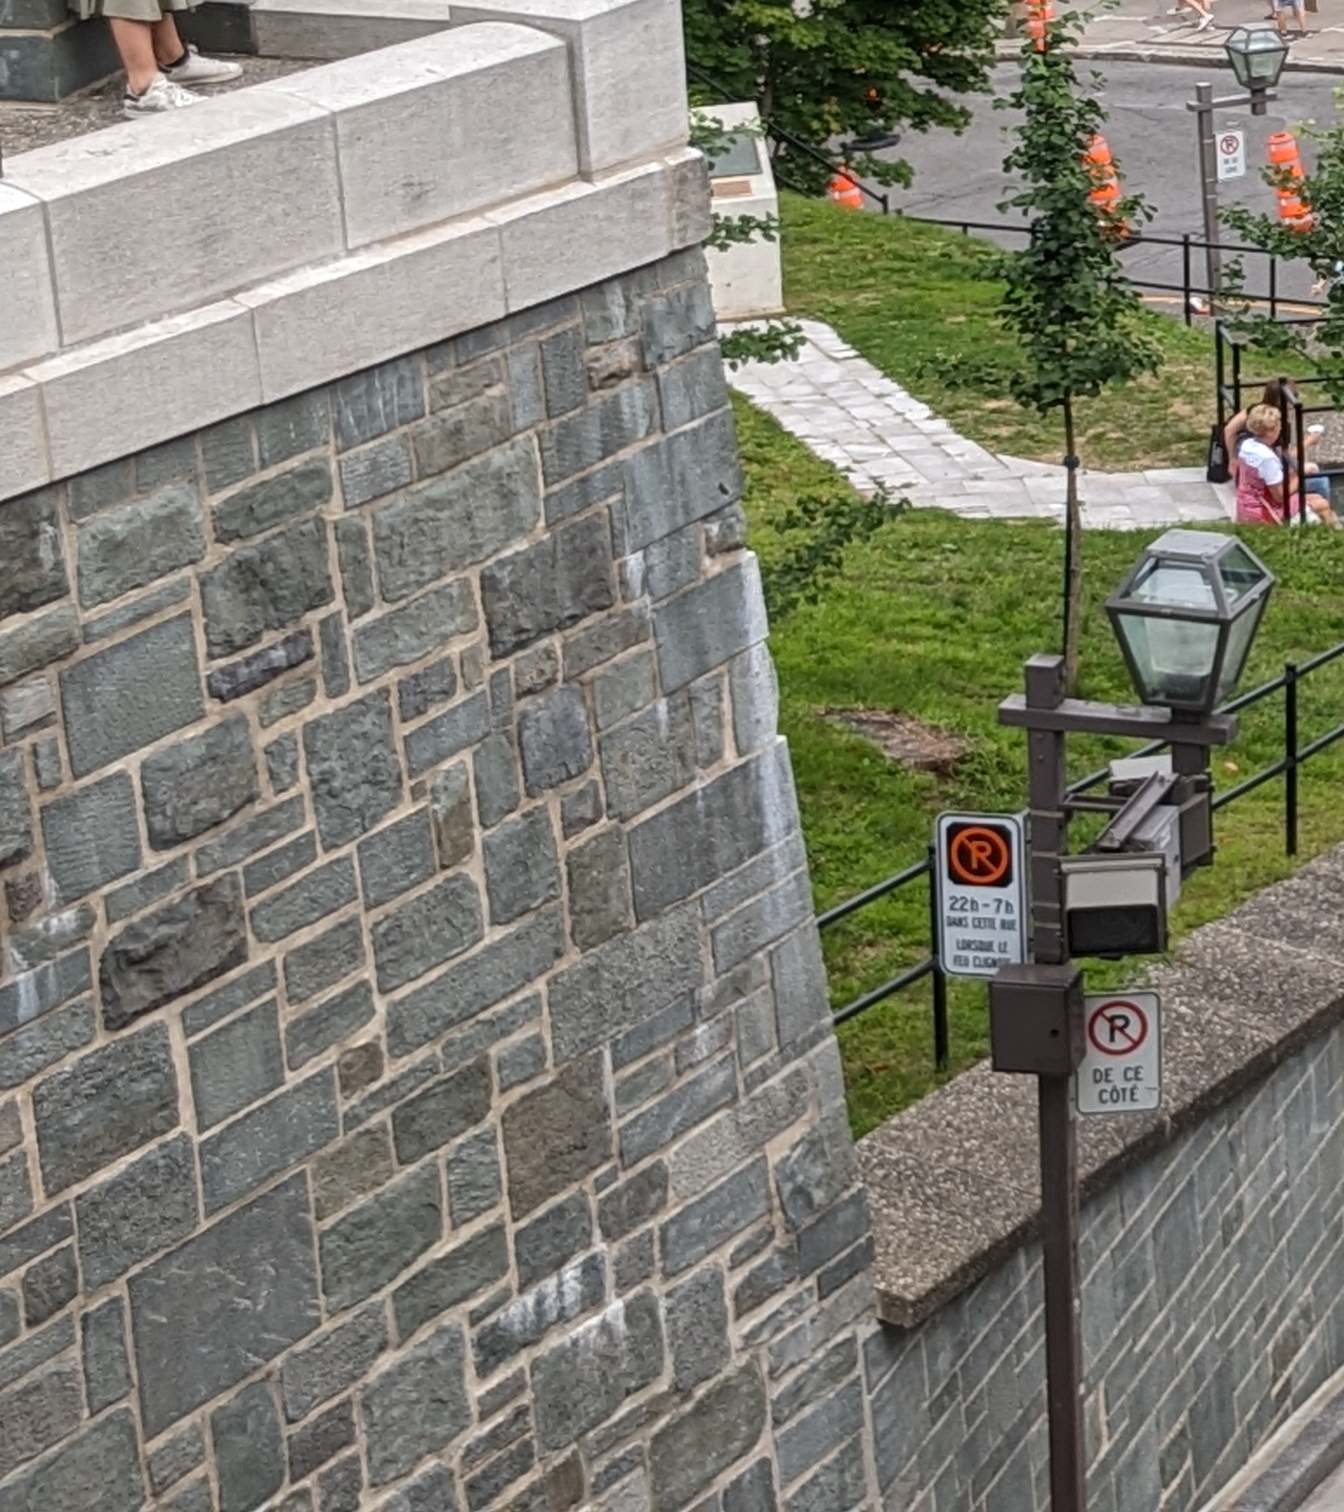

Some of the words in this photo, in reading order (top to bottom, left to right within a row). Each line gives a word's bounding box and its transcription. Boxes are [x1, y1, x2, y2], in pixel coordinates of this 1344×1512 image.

[946, 915, 969, 928] DANS
[972, 916, 998, 930] CETTE
[1001, 918, 1017, 932] RUE
[956, 938, 996, 953] LORSQUE
[998, 940, 1009, 954] LE
[953, 955, 970, 968] FEU
[1093, 1067, 1114, 1084] DE
[1123, 1065, 1144, 1082] CE
[1098, 1083, 1140, 1105] CÔTÉ
